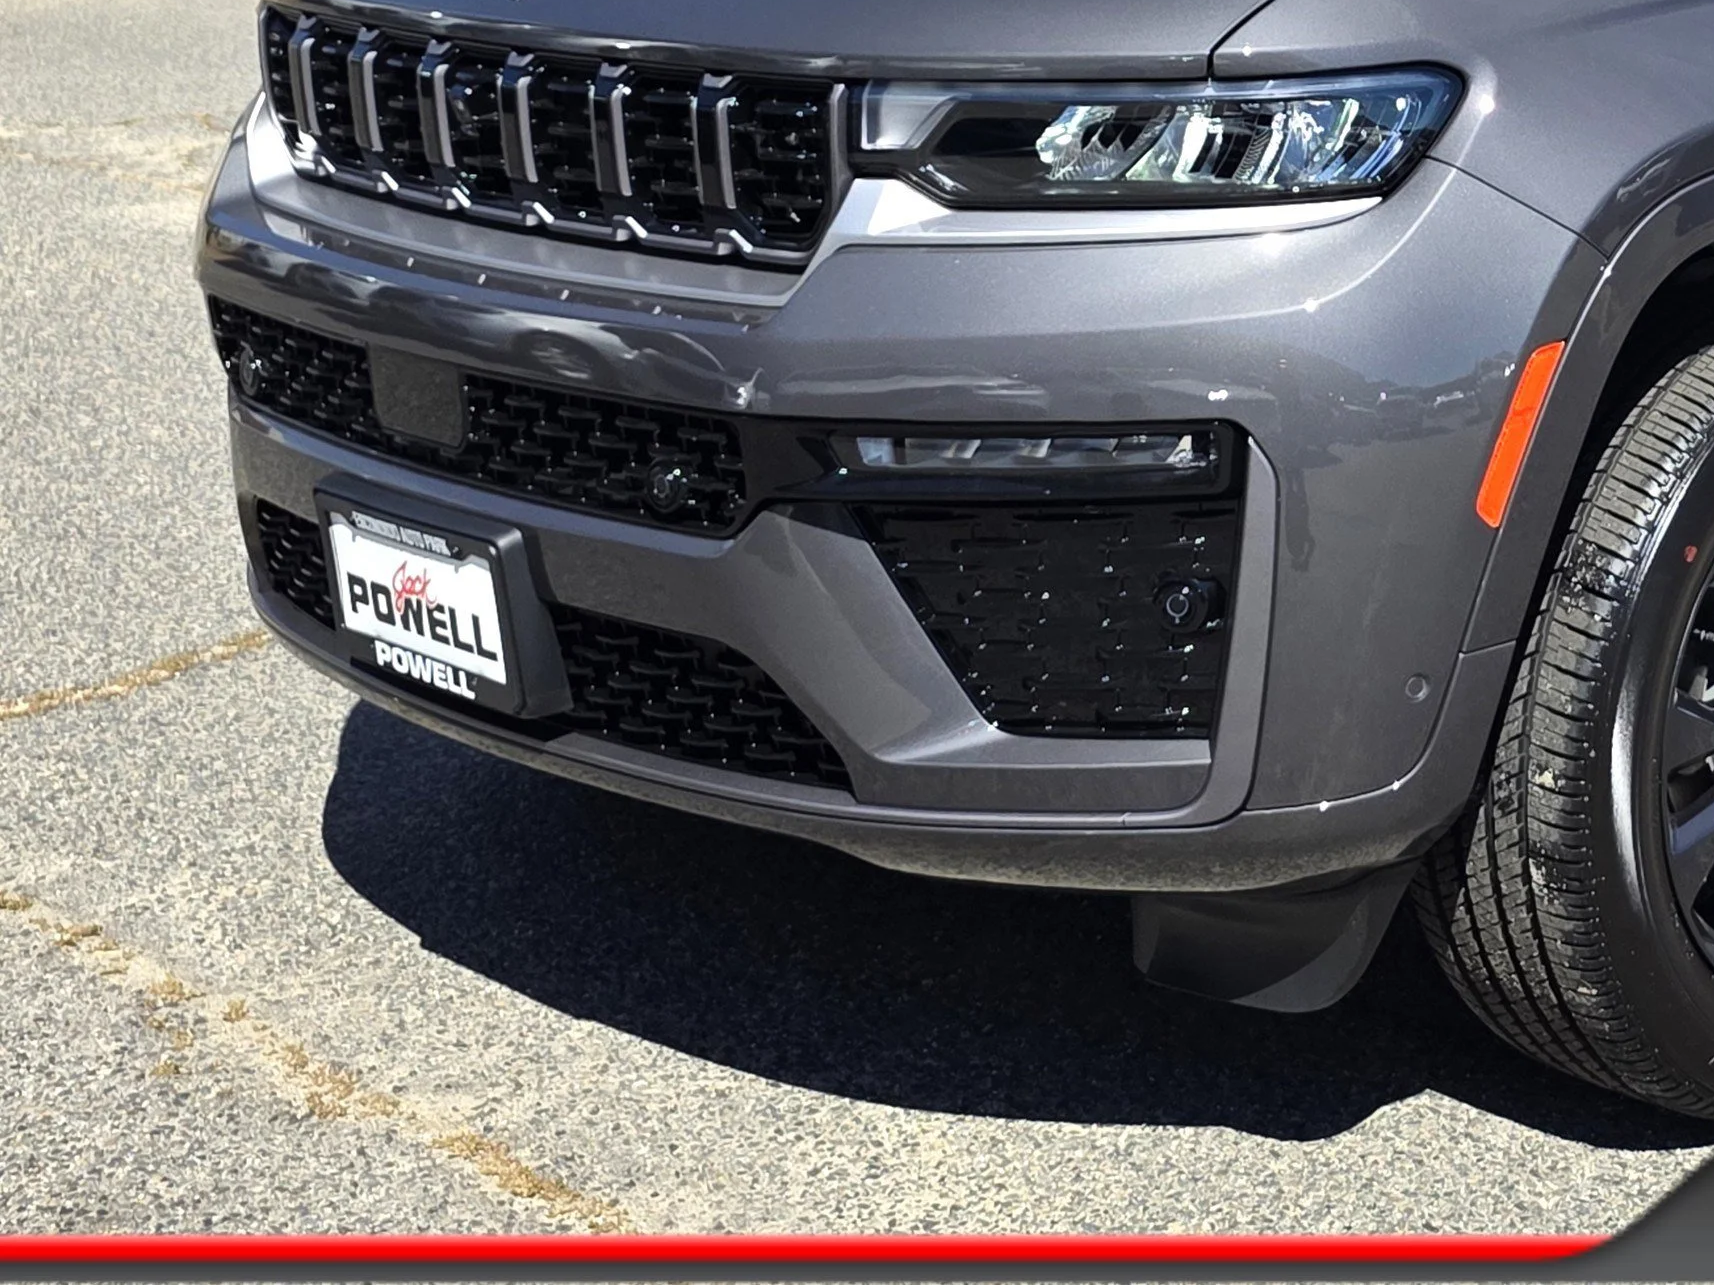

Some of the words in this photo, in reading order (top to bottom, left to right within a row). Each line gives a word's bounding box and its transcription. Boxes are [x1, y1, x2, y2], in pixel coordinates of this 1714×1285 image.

[347, 572, 498, 662] POWELL
[392, 560, 438, 615] Jack
[374, 639, 477, 701] POWELL
